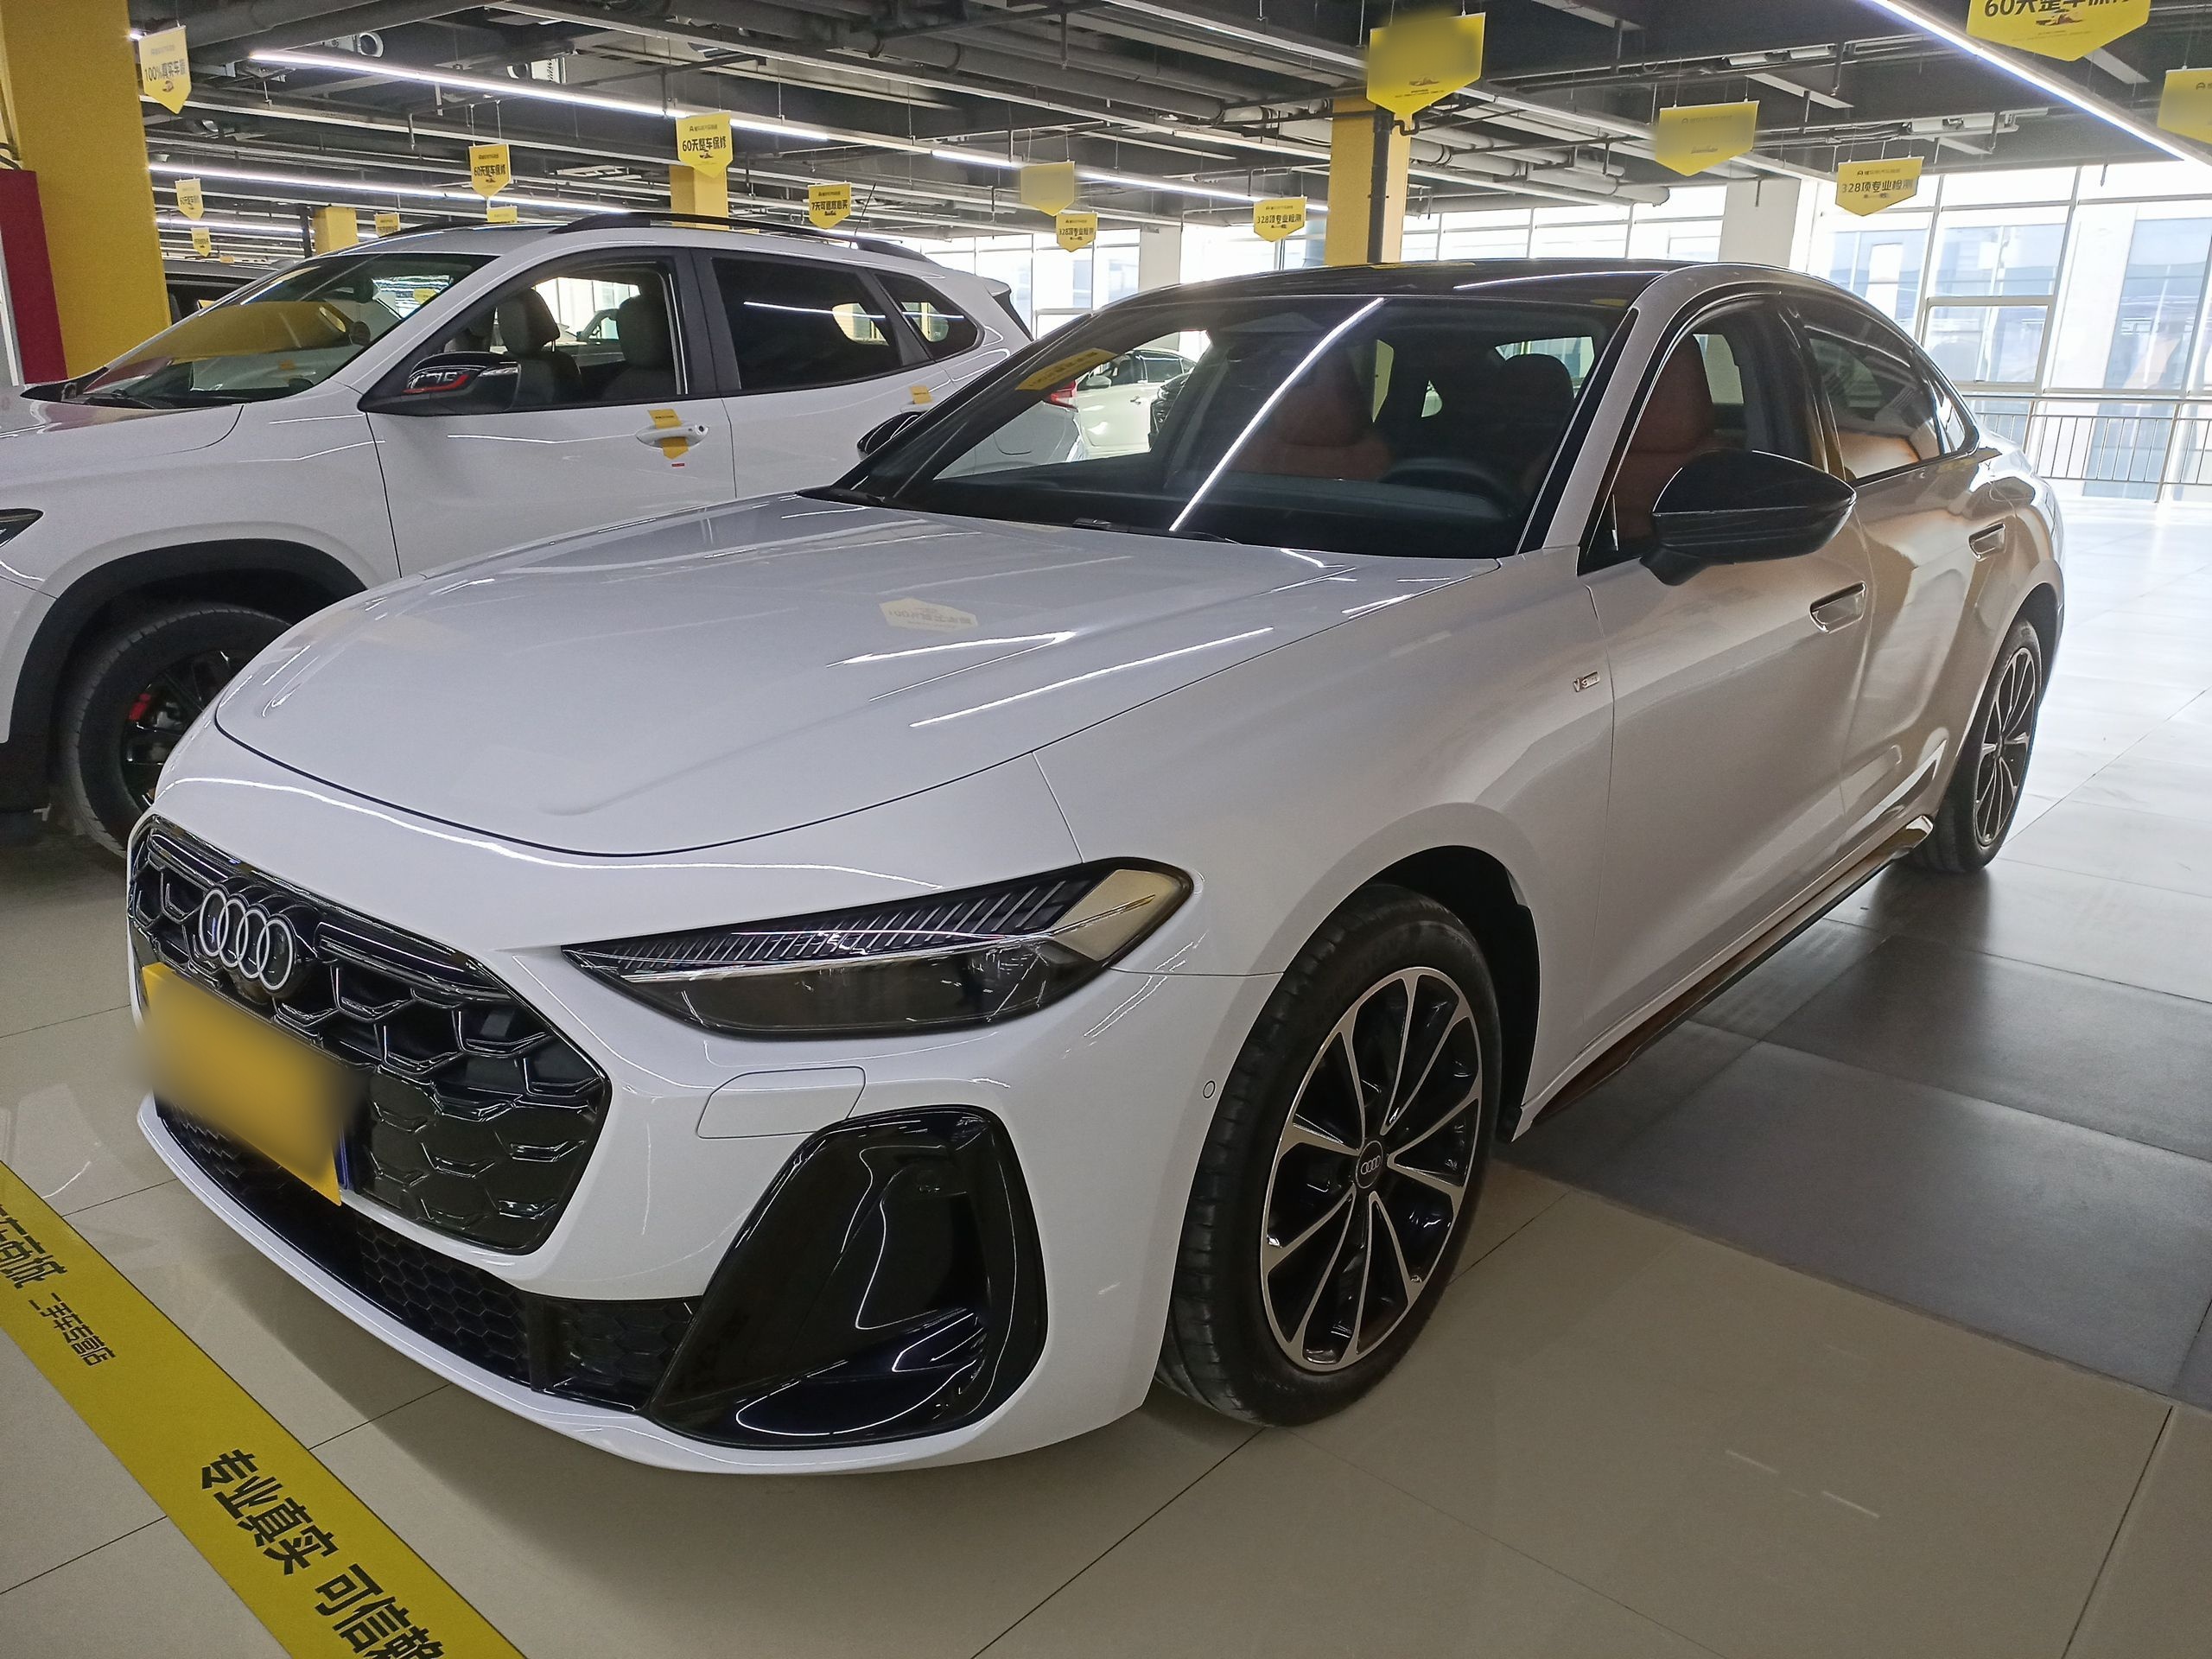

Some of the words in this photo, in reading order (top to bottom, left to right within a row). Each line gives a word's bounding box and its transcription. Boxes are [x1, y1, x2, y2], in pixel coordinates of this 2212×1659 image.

[682, 136, 727, 152] 60天整车保修
[29, 1292, 117, 1367] 二手车专营店
[201, 1448, 339, 1575] 专业真实
